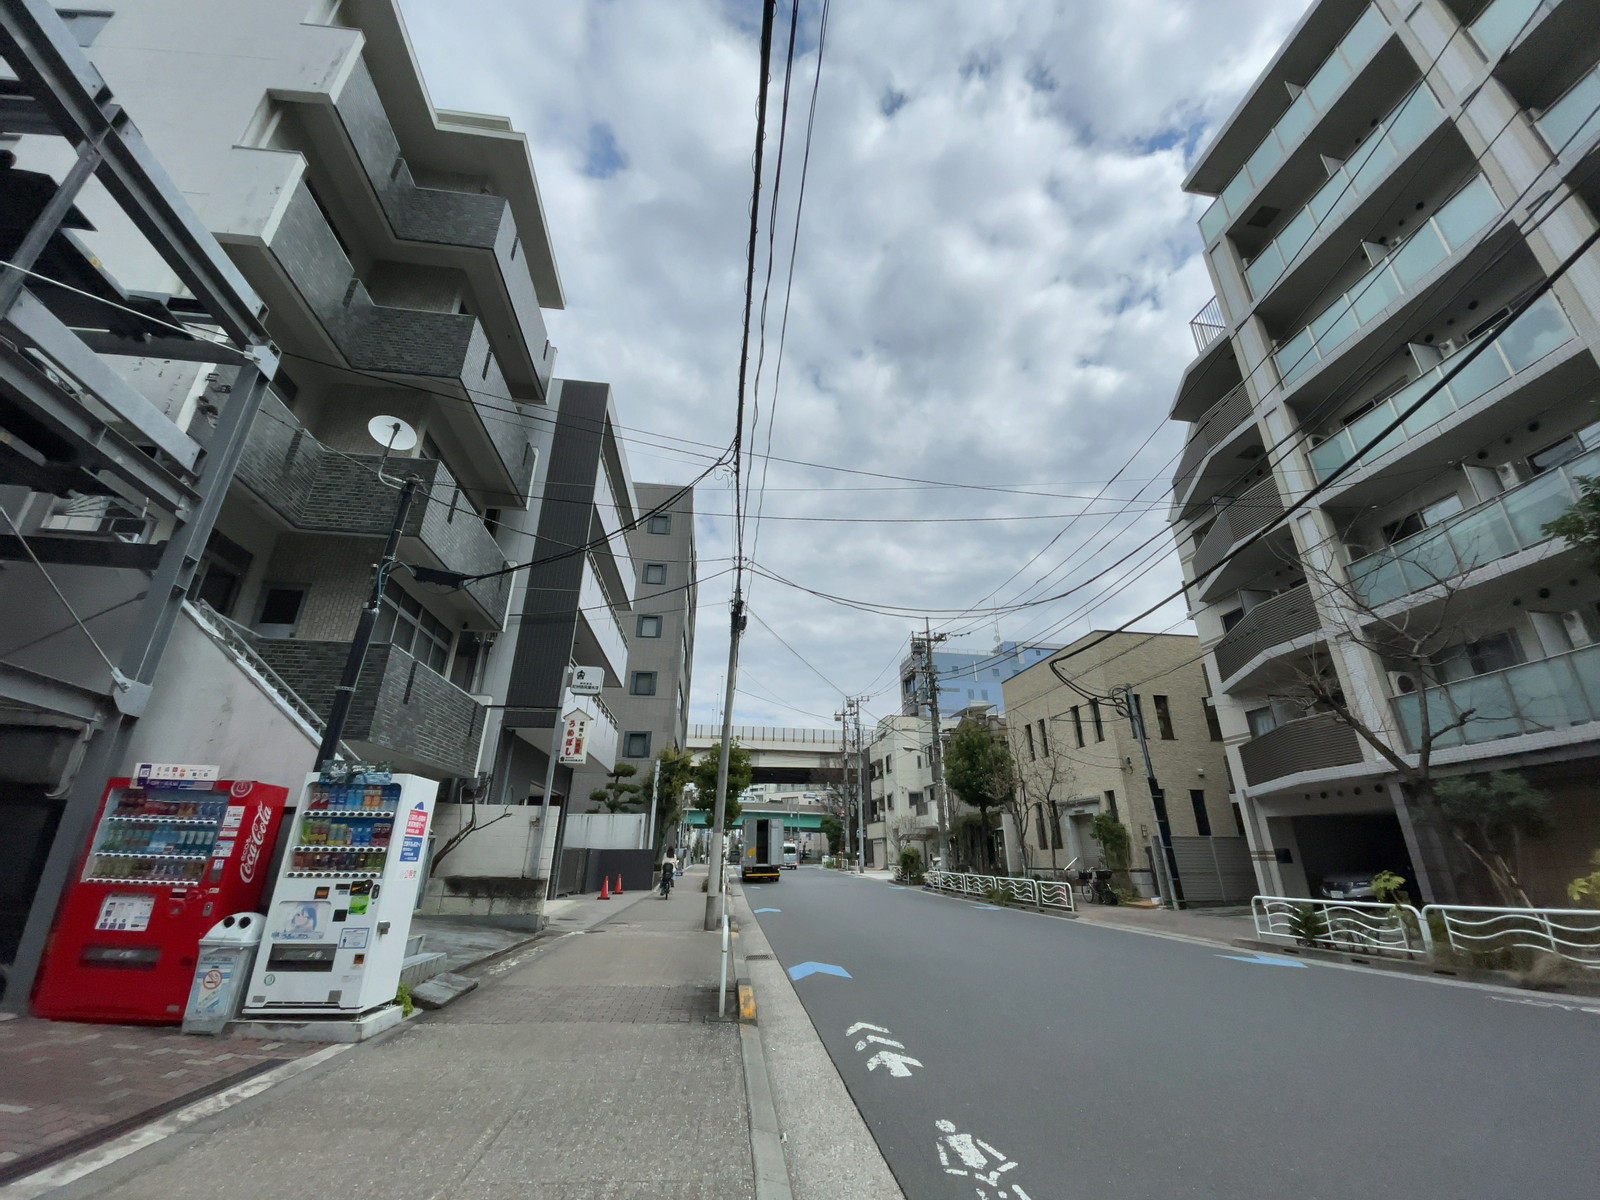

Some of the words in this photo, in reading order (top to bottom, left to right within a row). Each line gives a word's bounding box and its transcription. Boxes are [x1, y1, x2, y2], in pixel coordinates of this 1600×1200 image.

[565, 720, 576, 756] うめぼし
[240, 801, 272, 883] Coca-Cola
